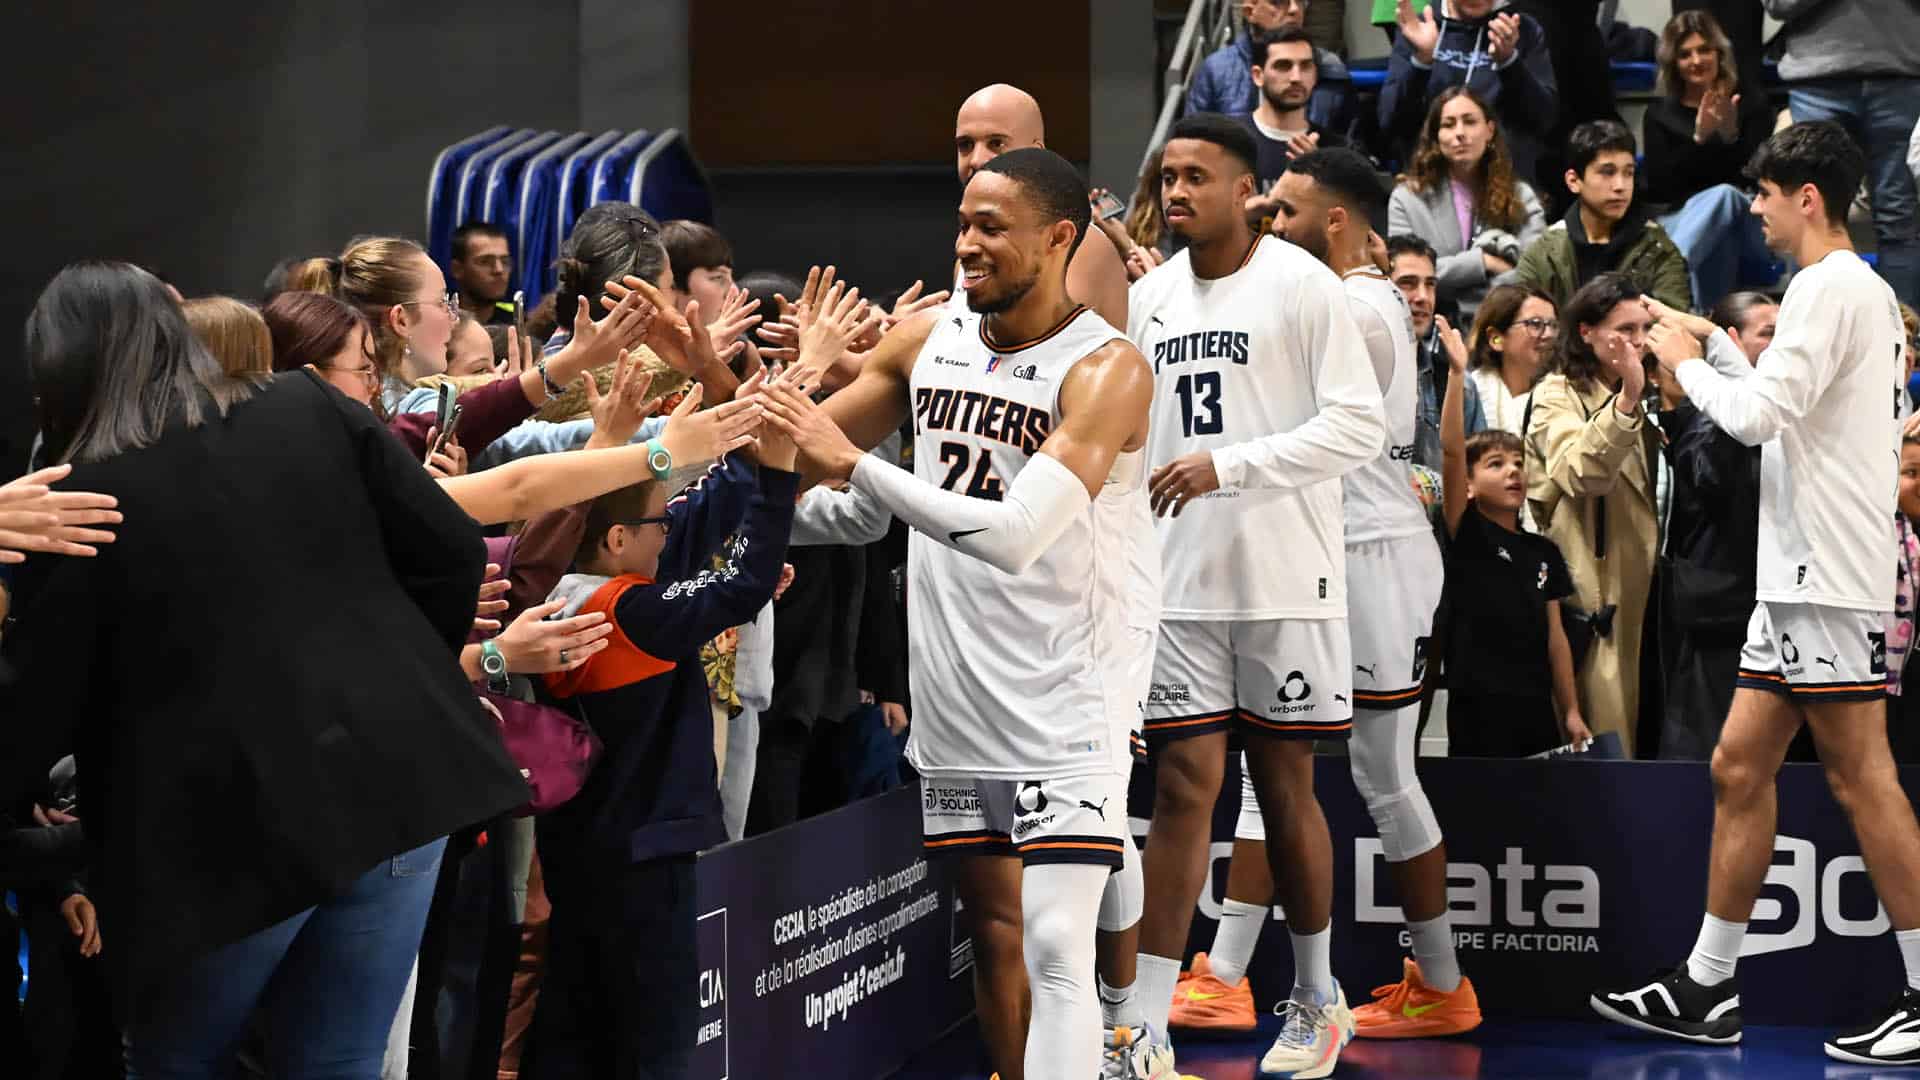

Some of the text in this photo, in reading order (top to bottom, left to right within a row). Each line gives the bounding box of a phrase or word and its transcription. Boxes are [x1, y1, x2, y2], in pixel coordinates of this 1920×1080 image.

[1154, 330, 1249, 375] POITIERS
[916, 387, 1051, 457] POITIERS
[1175, 371, 1223, 438] 13
[939, 441, 1004, 502] 24
[1270, 703, 1316, 714] urbaser
[807, 904, 817, 932] le
[818, 887, 865, 935] spécialiste
[865, 878, 877, 906] de
[877, 874, 886, 901] la
[886, 856, 928, 896] conception
[755, 968, 766, 998] et
[768, 962, 782, 992] de
[783, 957, 794, 985] la
[794, 936, 843, 980] réalisation
[877, 890, 939, 945] agroalimentaires
[1492, 934, 1599, 953] FACTORIA
[805, 993, 823, 1028] Un
[823, 970, 860, 1032] projet
[866, 944, 905, 996] cecia.fr
